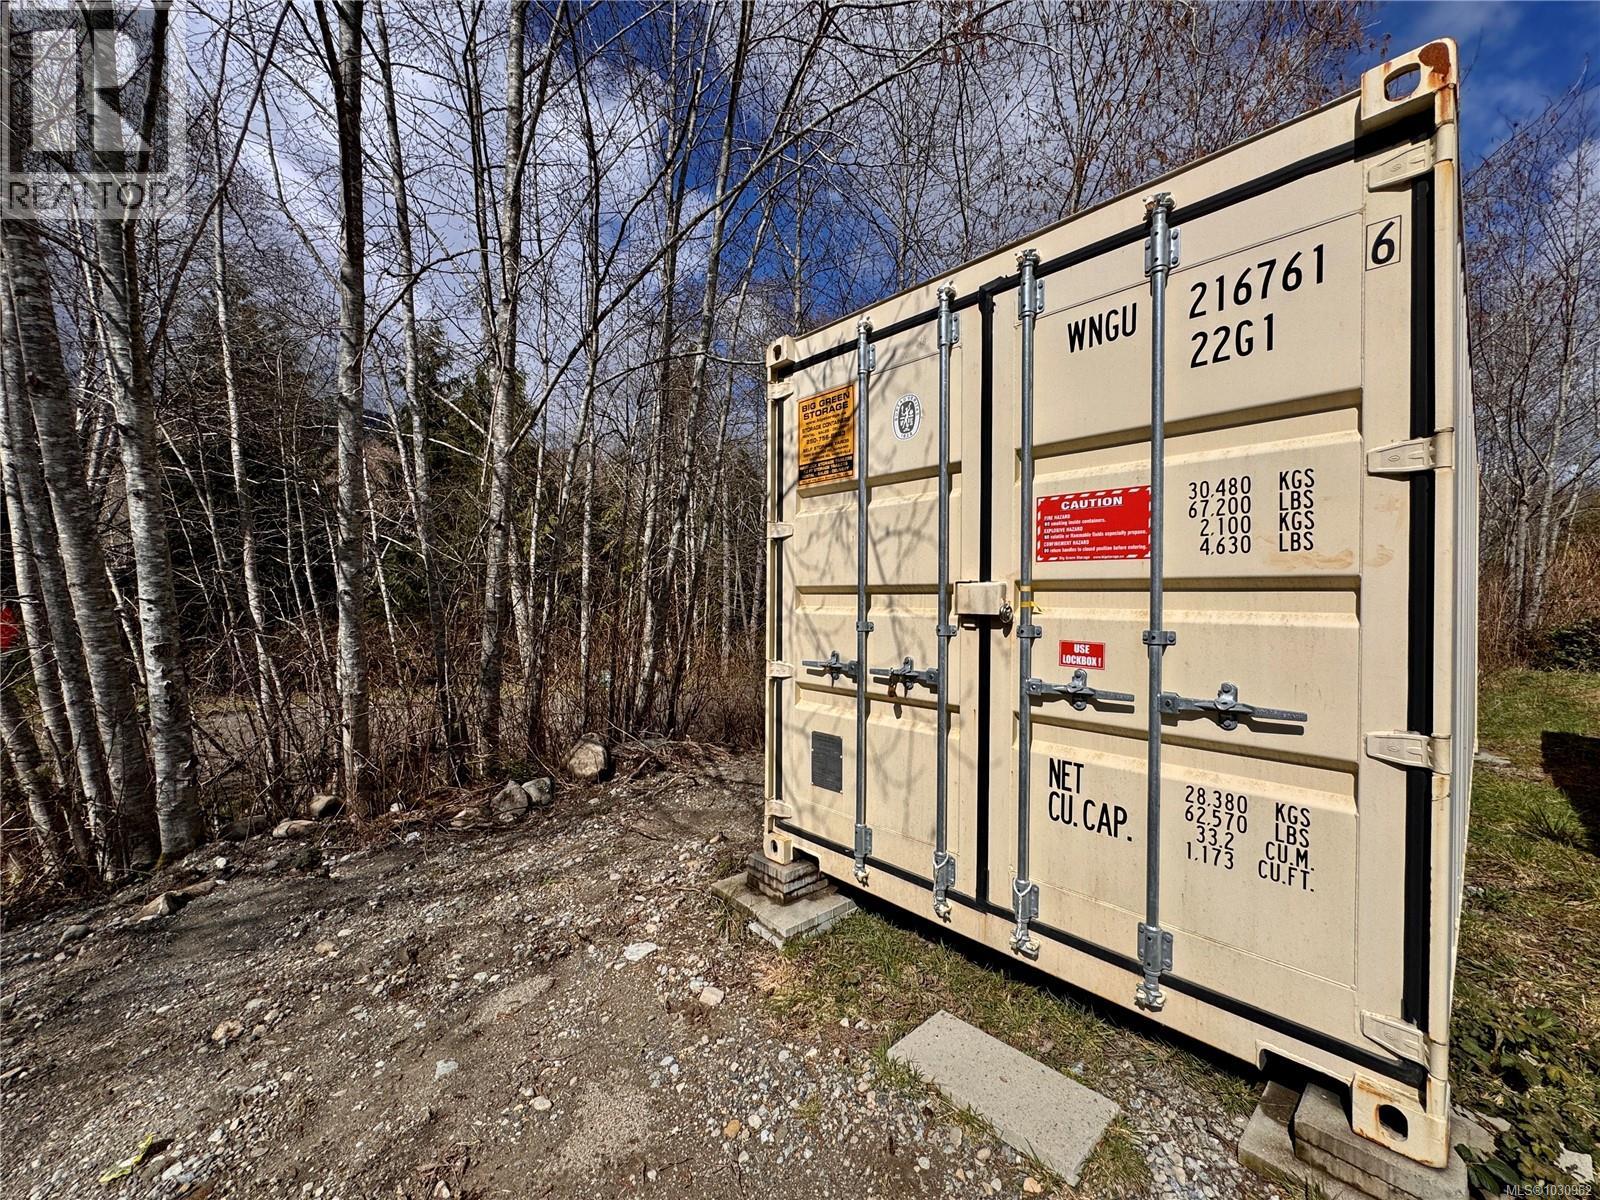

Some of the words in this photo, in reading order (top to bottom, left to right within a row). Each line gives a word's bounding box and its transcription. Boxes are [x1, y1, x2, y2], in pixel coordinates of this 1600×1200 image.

[1067, 302, 1137, 353] WNGU
[1188, 244, 1324, 319] 216761
[1371, 221, 1396, 265] 6
[1190, 313, 1274, 368] 22G1
[802, 402, 816, 413] BIG
[819, 391, 850, 407] GREEN
[804, 401, 848, 420] STORAGE
[1279, 468, 1315, 490] KGS
[1061, 496, 1123, 510] CAUTION
[1279, 490, 1314, 511] LBS
[1279, 511, 1315, 531] KGS
[1279, 532, 1314, 552] LBS
[1074, 644, 1090, 653] USE
[1062, 654, 1096, 666] LOCKBOX
[1049, 757, 1084, 794] NET
[1275, 803, 1310, 828] KGS
[1197, 826, 1234, 851] 33.2
[1275, 823, 1309, 848] LBS
